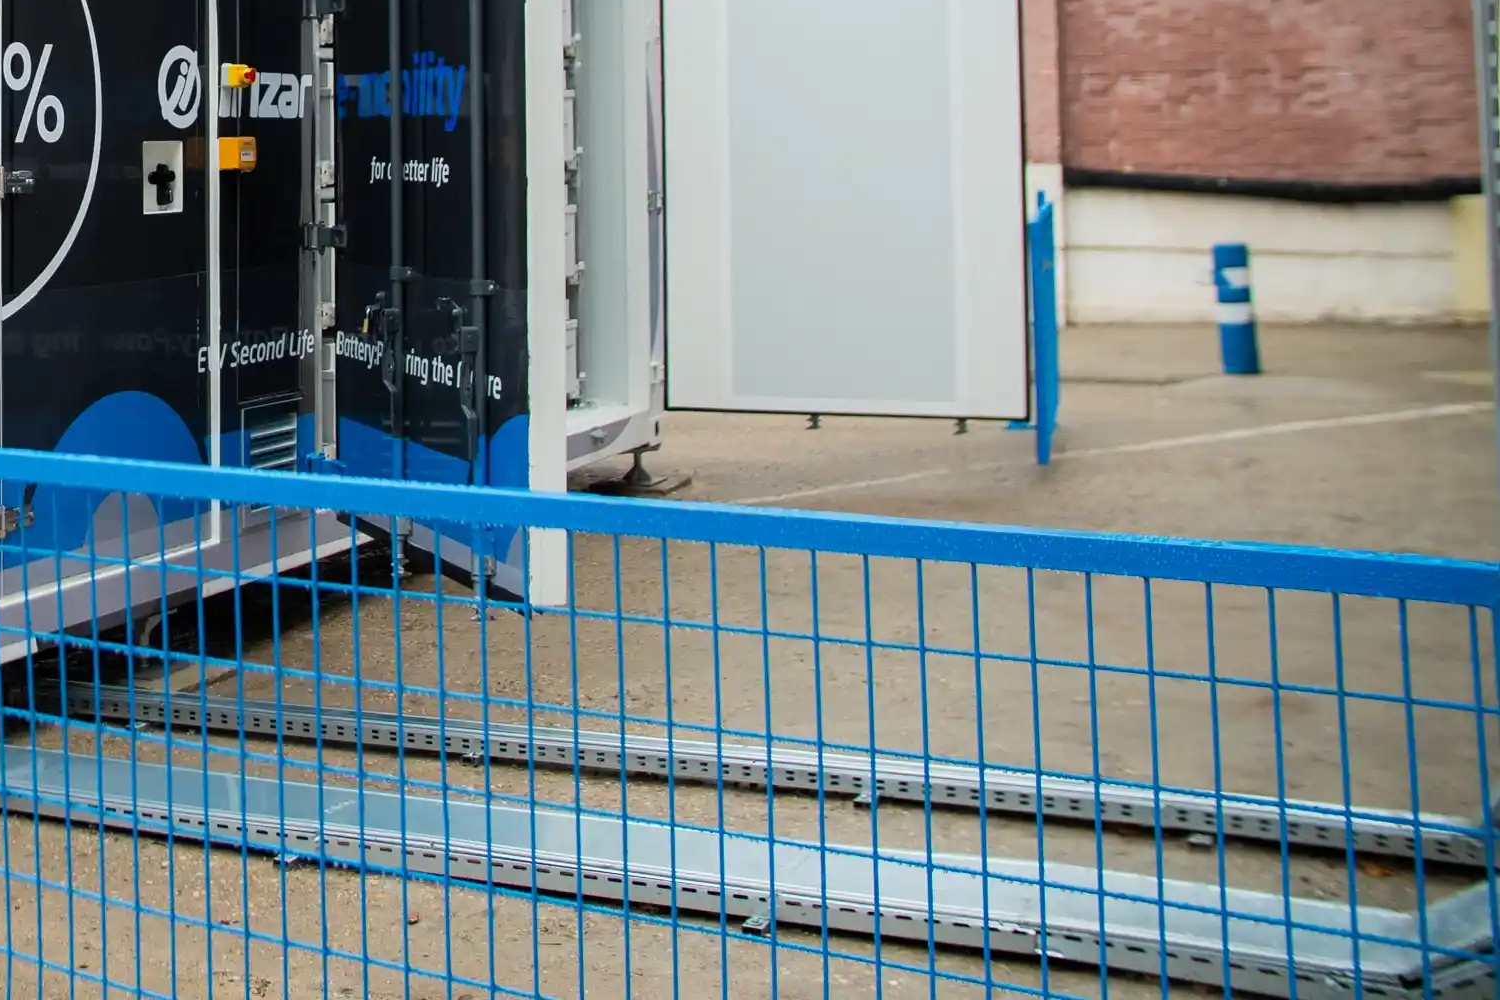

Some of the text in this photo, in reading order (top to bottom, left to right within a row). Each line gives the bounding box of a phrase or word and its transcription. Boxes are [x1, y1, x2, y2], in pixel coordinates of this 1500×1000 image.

[370, 156, 386, 184] for
[402, 159, 429, 183] etter
[431, 157, 450, 188] life
[230, 333, 286, 368] Second
[289, 328, 315, 360] Life
[432, 355, 453, 386] the
